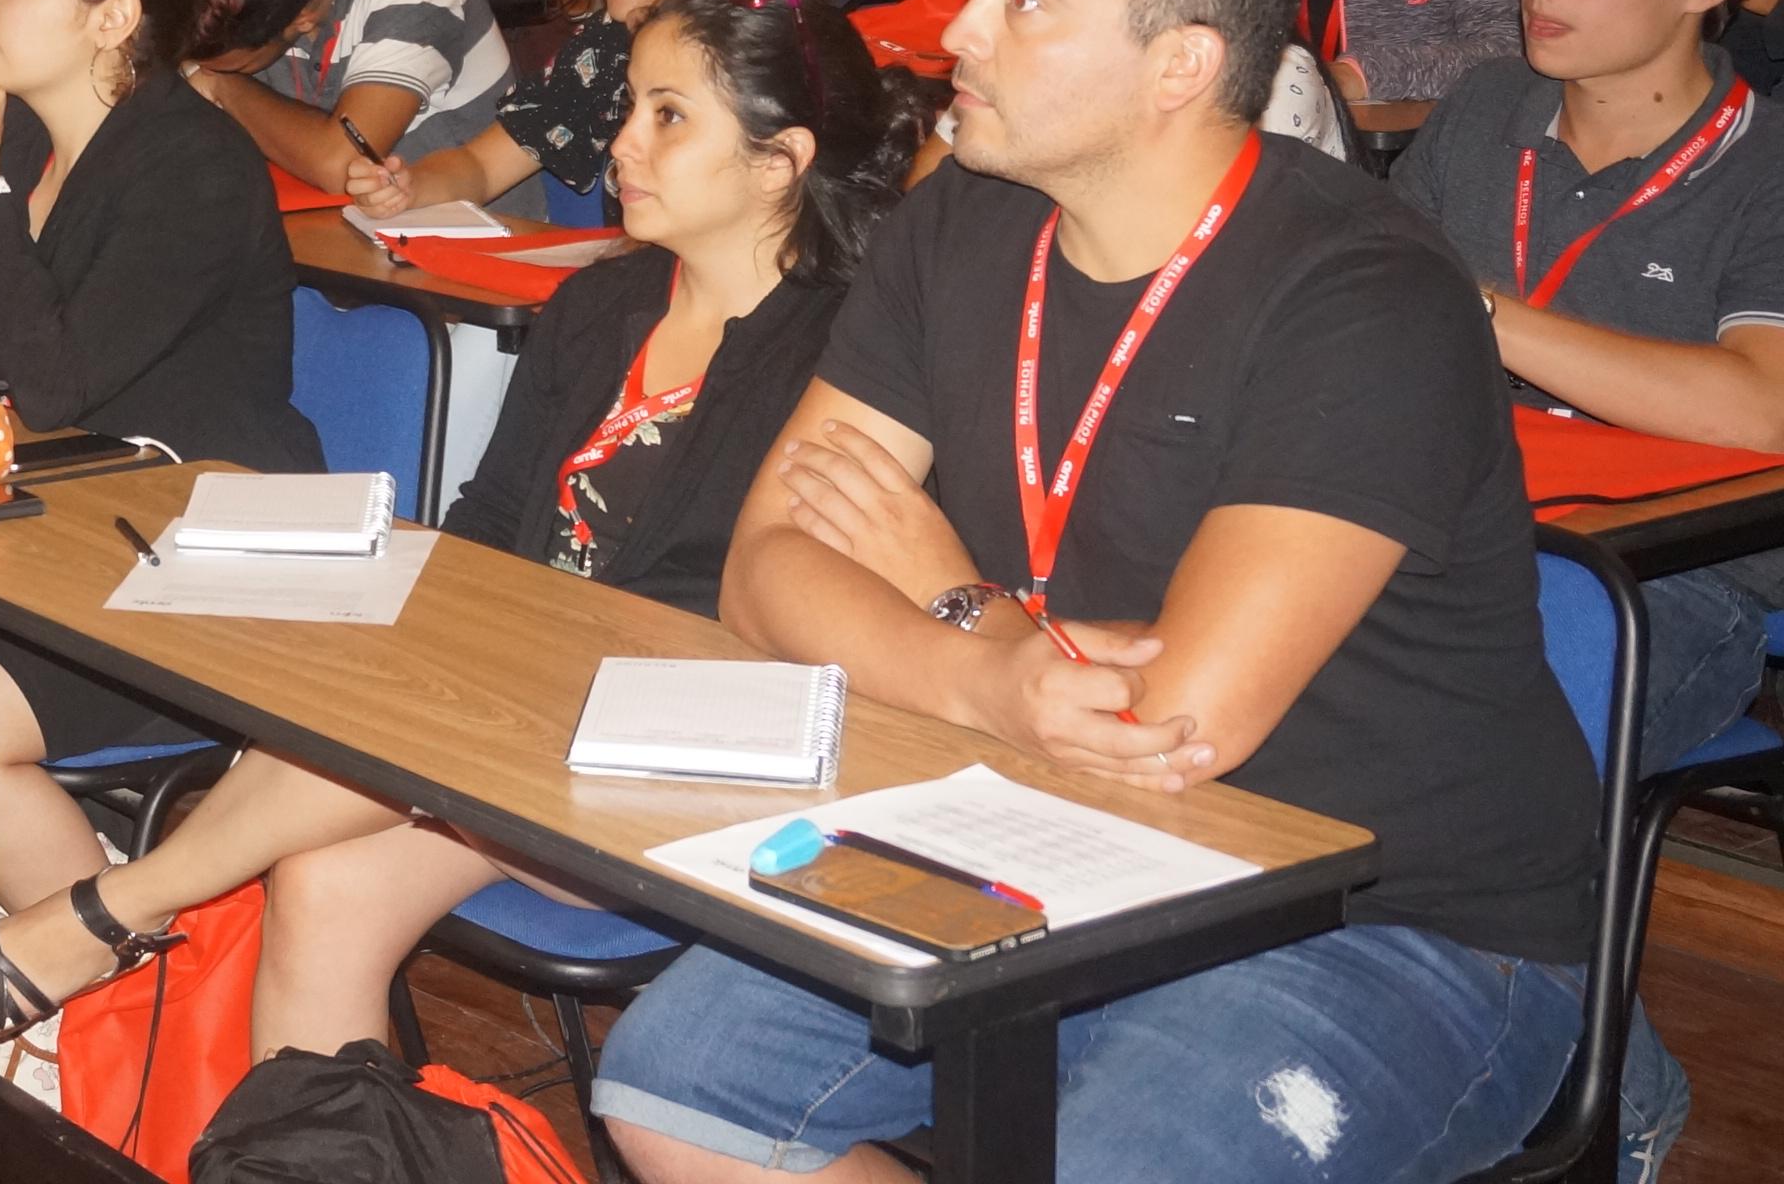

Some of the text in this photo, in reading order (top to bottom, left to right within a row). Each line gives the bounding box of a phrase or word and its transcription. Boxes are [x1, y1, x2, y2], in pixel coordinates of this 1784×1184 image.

[1144, 255, 1189, 315] DELPHOS
[1019, 359, 1032, 425] DELPHOS
[1077, 385, 1112, 447] DELPHOS
[602, 408, 650, 438] DELPHOS
